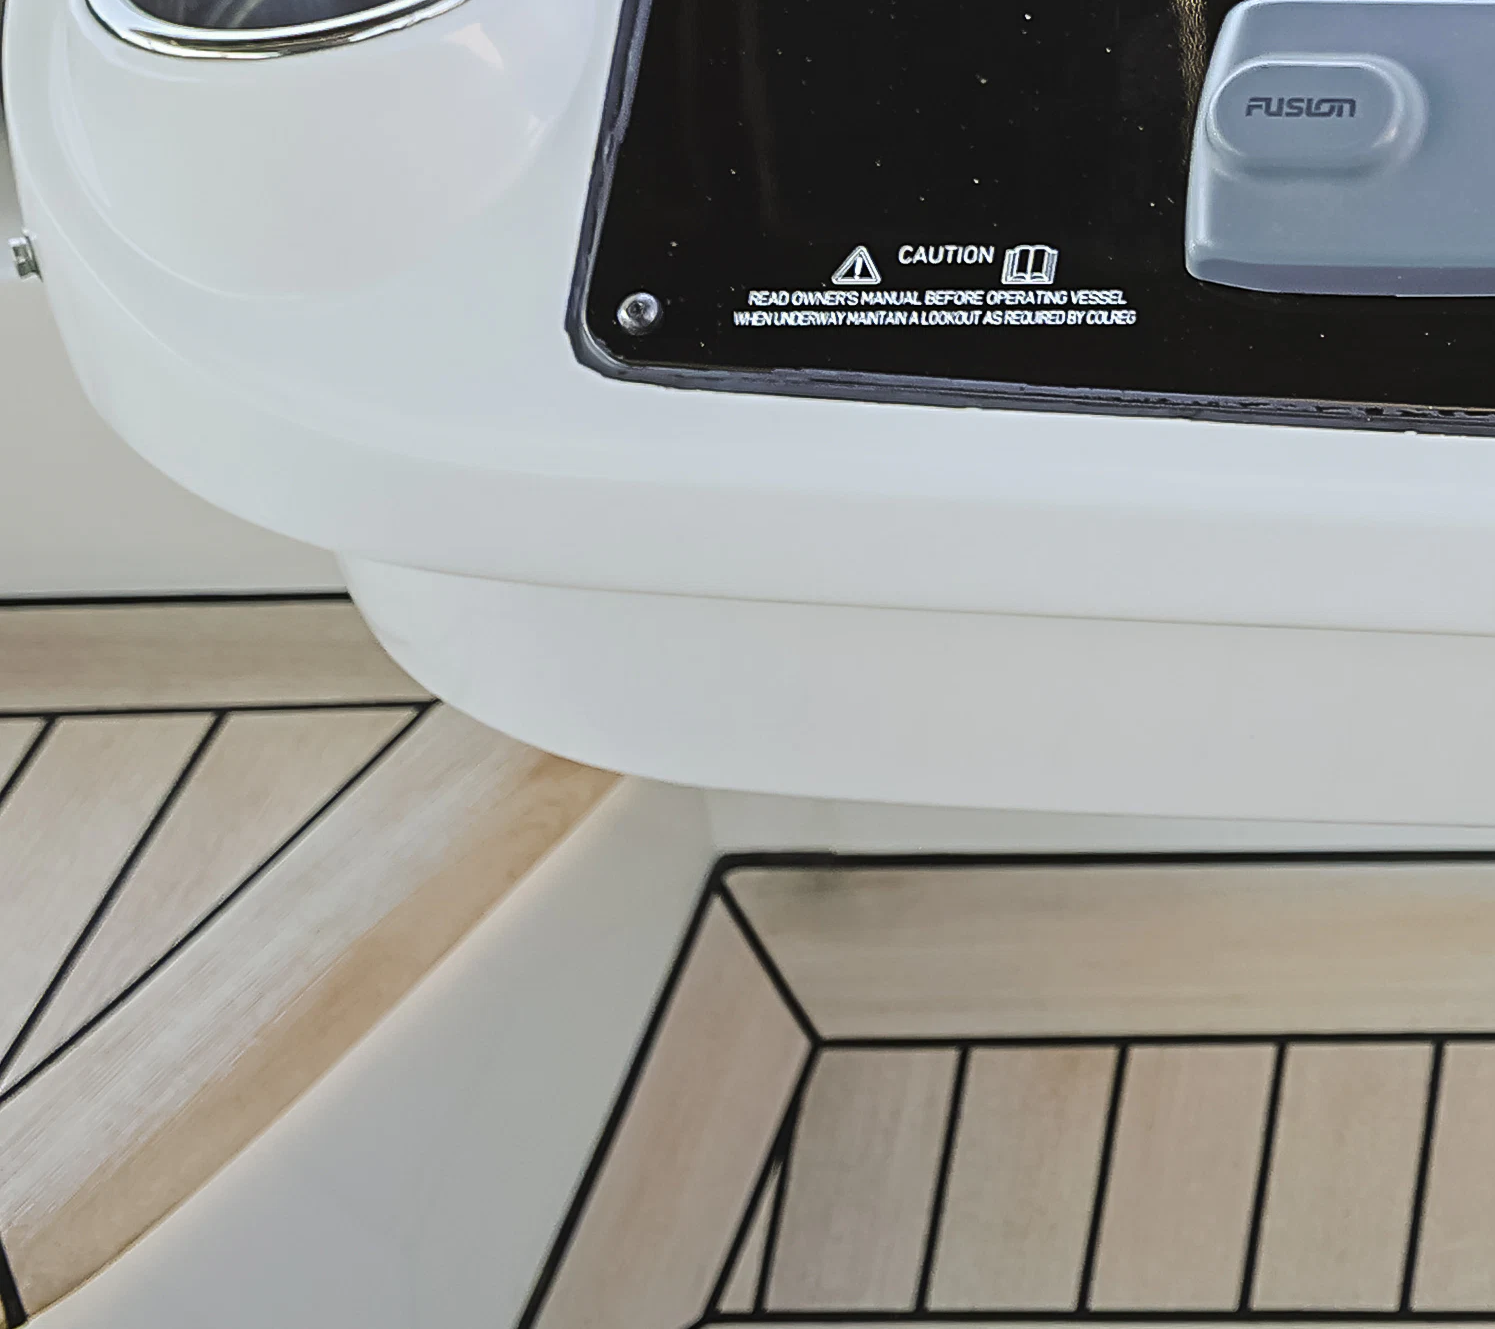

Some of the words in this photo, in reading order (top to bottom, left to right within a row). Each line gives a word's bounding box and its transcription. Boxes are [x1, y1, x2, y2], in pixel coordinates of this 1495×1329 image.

[1245, 97, 1356, 118] FUSION
[898, 245, 994, 264] CAUTION
[748, 290, 789, 306] READ
[791, 290, 859, 306] OWNER'S
[860, 290, 921, 306] MANUAL
[924, 290, 985, 305] BEFORE
[986, 290, 1068, 305] OPERATING
[1070, 290, 1127, 305] VESSEL
[733, 310, 772, 326] WHEN
[773, 310, 845, 326] UNDERWAY
[909, 311, 919, 325] A
[921, 310, 982, 325] LOOKOUT
[983, 310, 1002, 325] AS
[1004, 310, 1065, 325] REQUIRED
[1067, 310, 1086, 325] BY
[1086, 309, 1137, 325] COLREG
